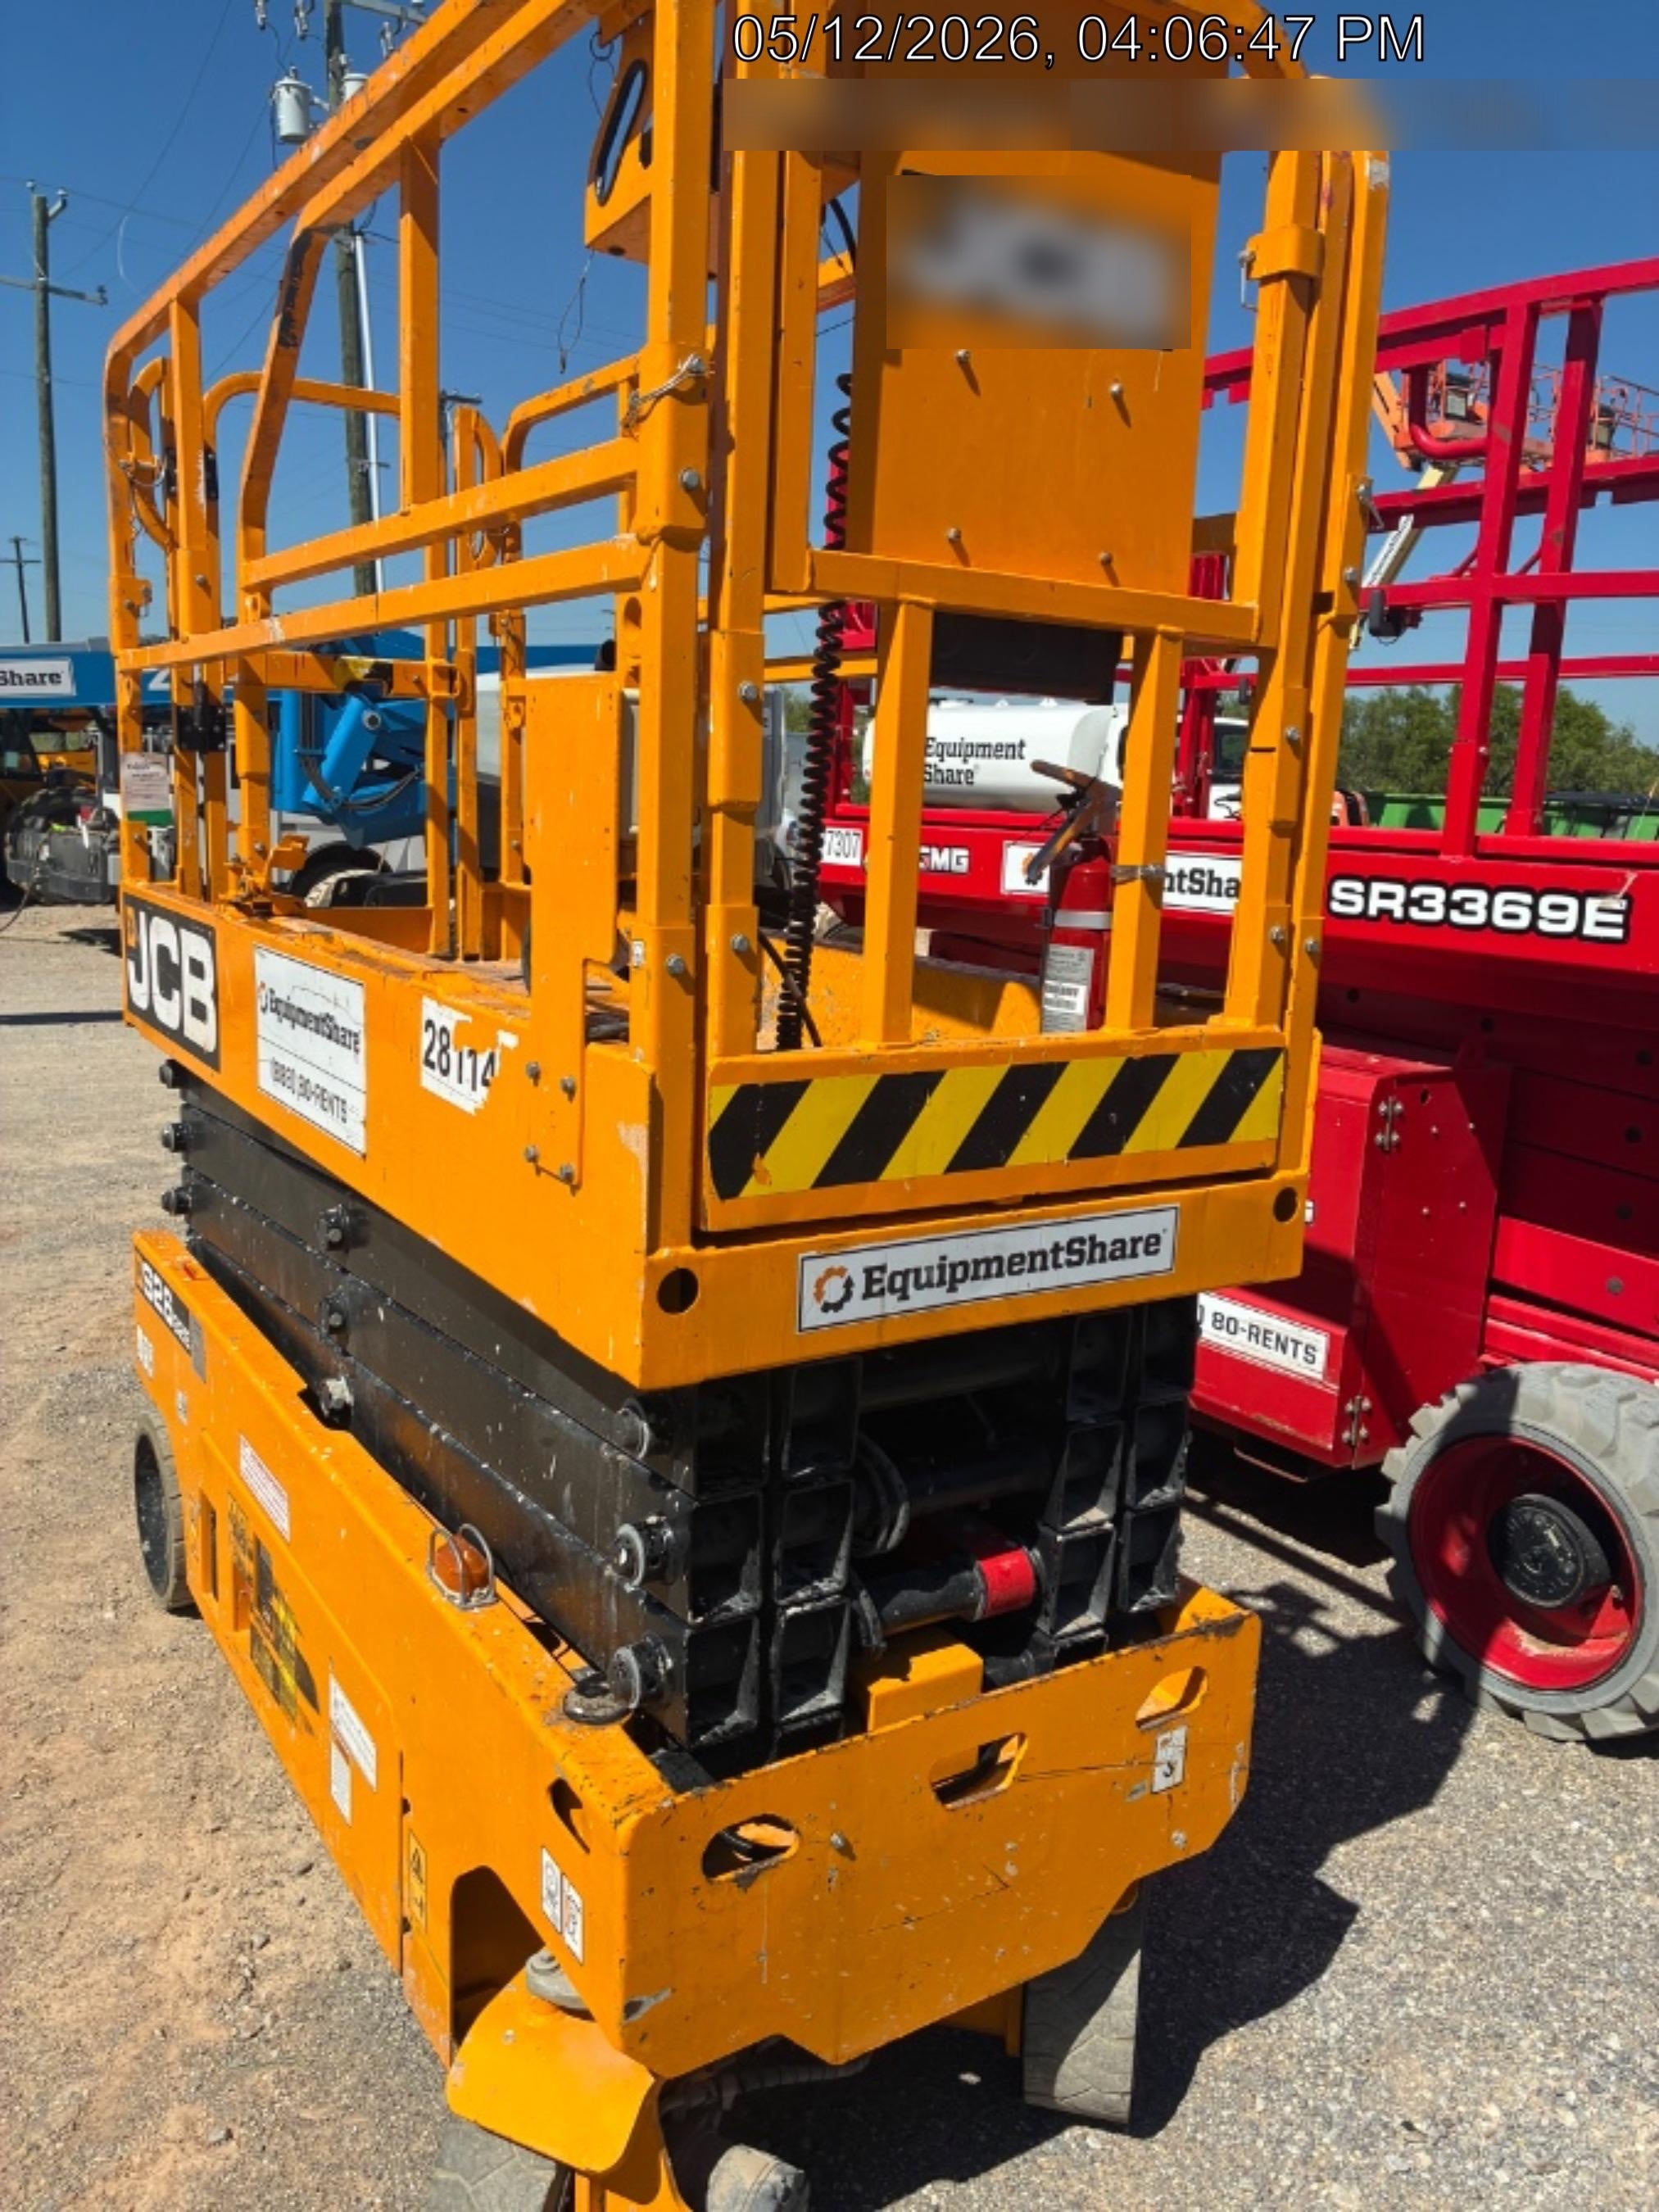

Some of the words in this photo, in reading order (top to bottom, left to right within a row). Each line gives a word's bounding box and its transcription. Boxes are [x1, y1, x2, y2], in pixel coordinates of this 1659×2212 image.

[924, 764, 974, 784] Share
[925, 736, 1026, 764] Equipment
[1329, 877, 1630, 941] SR3369E
[128, 910, 217, 1053] JCB
[862, 1232, 1164, 1301] EquipmentShare
[1212, 1312, 1316, 1364] 80-RENTS
